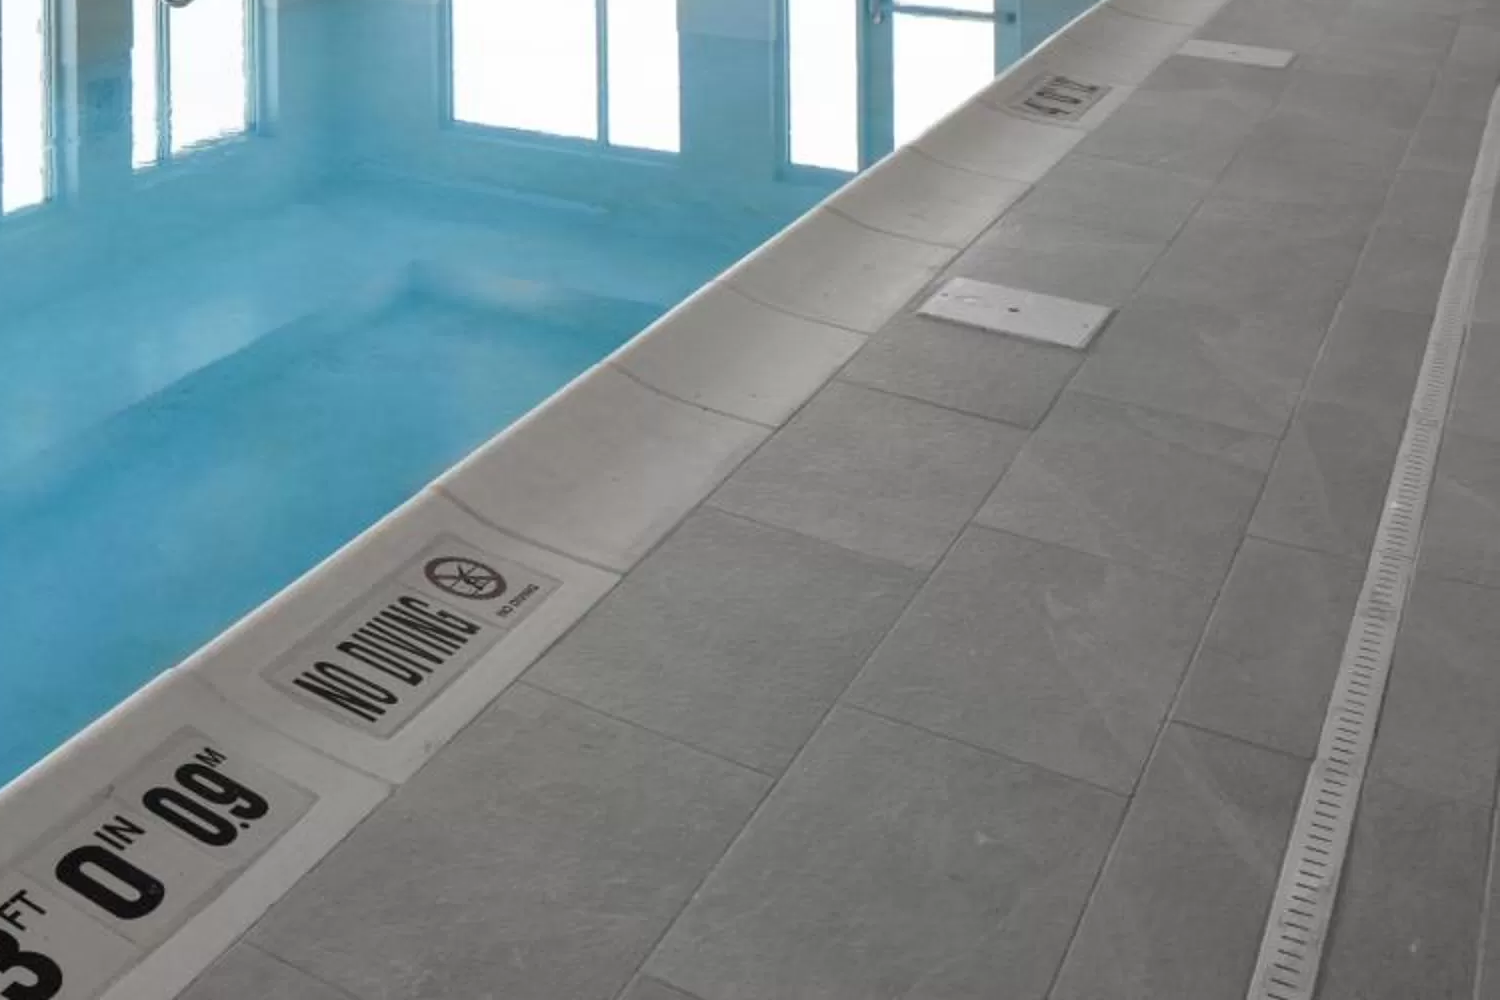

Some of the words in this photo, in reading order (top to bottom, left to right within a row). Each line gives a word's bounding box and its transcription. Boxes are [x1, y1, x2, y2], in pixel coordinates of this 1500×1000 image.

[335, 596, 482, 687] DIVING
[292, 661, 399, 723] NO
[195, 747, 228, 768] M
[94, 815, 146, 851] IN
[55, 845, 165, 920] 0
